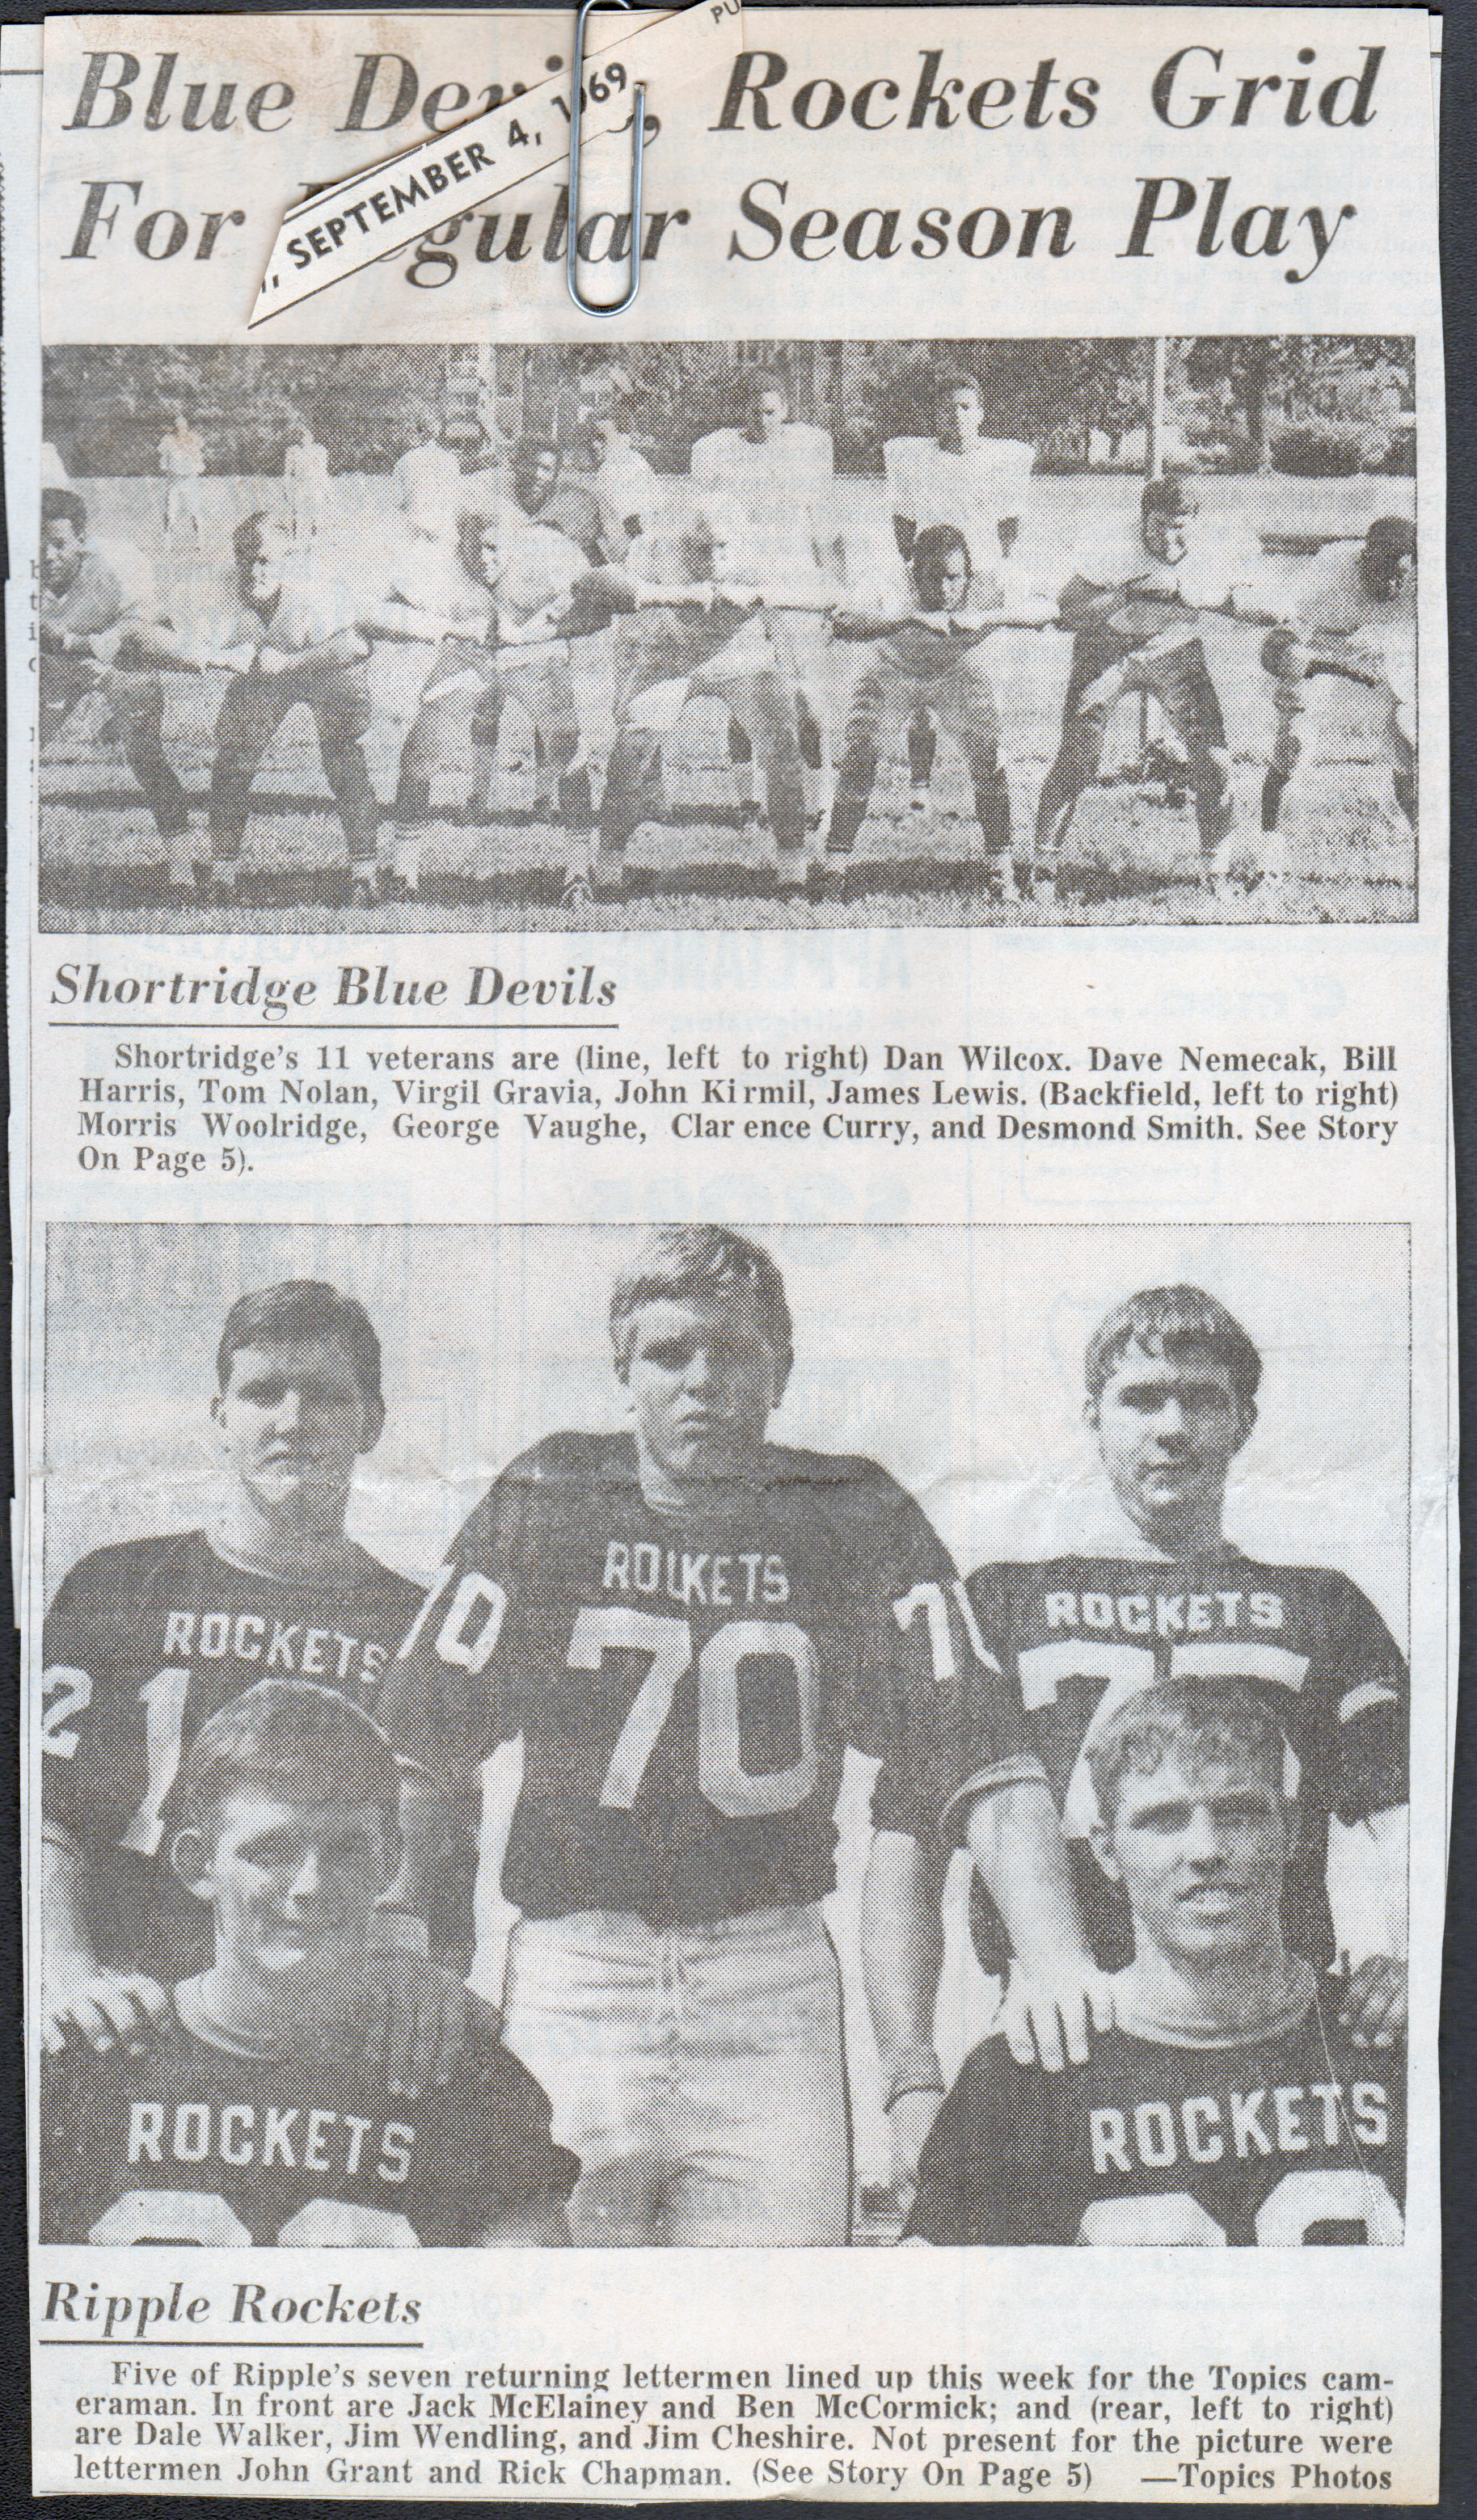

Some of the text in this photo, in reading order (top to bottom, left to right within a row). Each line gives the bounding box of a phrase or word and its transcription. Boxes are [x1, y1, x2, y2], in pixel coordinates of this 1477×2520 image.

[62, 52, 293, 131] Blue
[708, 49, 1099, 131] Rockets
[1152, 45, 1386, 129] Grid
[286, 62, 627, 270] SEPTEMBER 4, 169
[61, 175, 1356, 289] For gular Season Play
[49, 964, 617, 1019] Shortridge Blue Devils
[115, 1043, 1397, 1077] Shortridge's 11 veterans are (line, left to right) Dan Wilcox. Dave Nemecak, Bill
[78, 1077, 185, 1108] Harris,
[198, 1079, 265, 1103] Tom
[281, 1080, 378, 1105] Nolan,
[391, 1080, 479, 1110] Virgil
[493, 1079, 601, 1106] Gravia,
[614, 1079, 686, 1104] John
[826, 1080, 921, 1105] James
[931, 1081, 1028, 1106] Lewis.
[1039, 1080, 1201, 1108] (Backfield,
[1213, 1081, 1262, 1106] left
[1276, 1081, 1304, 1106] to
[1317, 1080, 1399, 1111] right)
[78, 1111, 177, 1136] Morris
[201, 1113, 367, 1144] Woolridge,
[392, 1114, 499, 1144] George
[523, 1113, 647, 1144] Vaughe,
[822, 1114, 919, 1145] Curry,
[931, 1115, 985, 1140] and
[997, 1115, 1134, 1140] Desmond
[1146, 1115, 1243, 1140] Smith.
[1255, 1115, 1306, 1140] See
[1318, 1115, 1399, 1146] Story
[78, 1146, 254, 1177] On Page 5).
[1044, 1591, 1284, 1635] ROCKETS
[163, 1612, 391, 1684] ROCKETS
[567, 1606, 817, 1818] 70
[128, 2103, 416, 2183] ROCKETS
[1089, 2080, 1389, 2174] ROCKETS
[44, 2282, 422, 2337] Ripple Rockets
[112, 2361, 1395, 2395] Five of Ripple's seven returning lettermen lined up this week for the Topics cam-
[75, 2391, 1394, 2425] eraman. In front are Jack McElainey and Ben McCormick; and (rear, left to right)
[74, 2421, 1394, 2460] are Dale Walker, Jim Wendling, and Jim Cheshire. Not present for the picture were
[75, 2454, 222, 2480] lettermen
[236, 2457, 310, 2483] John
[326, 2458, 412, 2483] Grant
[428, 2459, 482, 2484] and
[500, 2459, 565, 2484] Rick
[582, 2459, 731, 2489] Chapman.
[753, 2459, 813, 2484] (See
[827, 2459, 903, 2492] Story
[922, 2461, 963, 2486] On
[981, 2461, 1052, 2493] Page
[1066, 2462, 1093, 2490] 5)
[1290, 2463, 1392, 2490] Photos
